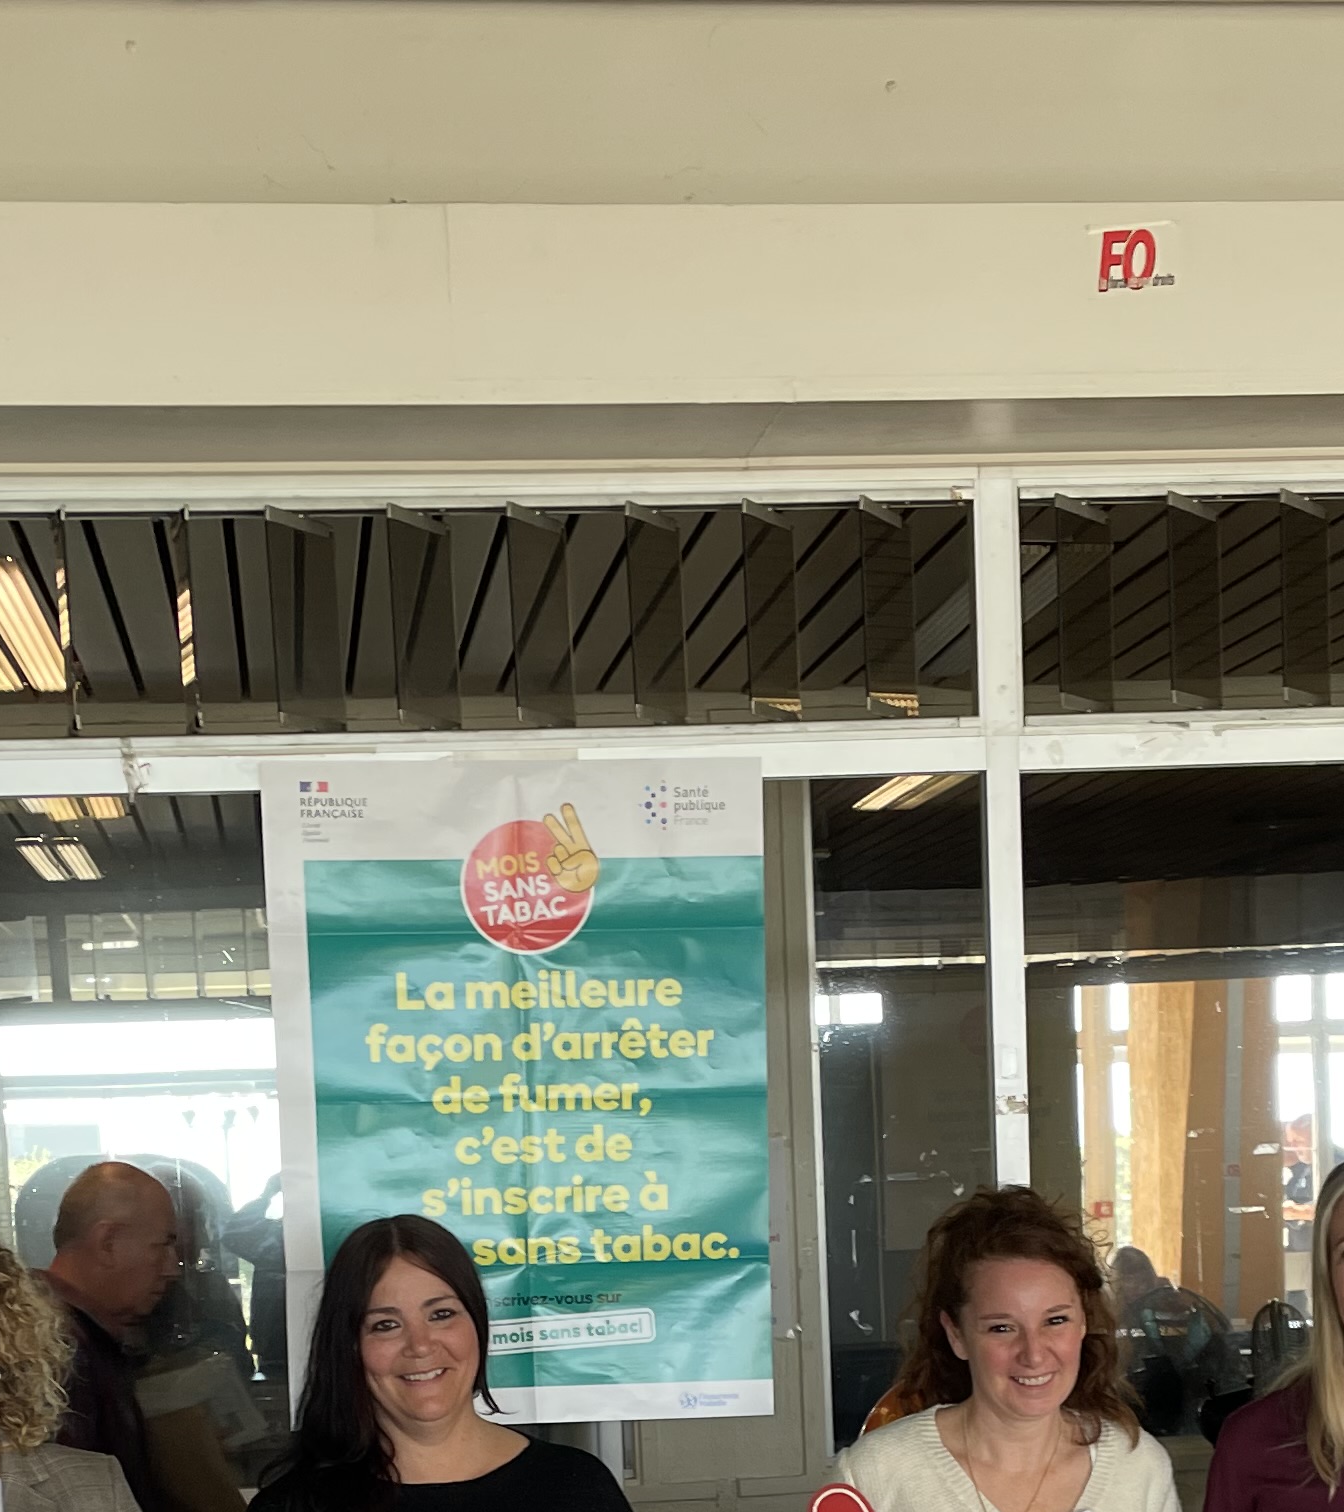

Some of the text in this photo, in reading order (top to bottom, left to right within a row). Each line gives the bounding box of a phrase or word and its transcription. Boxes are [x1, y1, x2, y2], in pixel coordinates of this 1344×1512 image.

[1098, 229, 1156, 292] FO
[299, 797, 368, 808] RÉPUBLIQUE
[673, 785, 709, 797] Santé
[299, 809, 364, 819] FRANÇAISE
[674, 800, 726, 813] publique
[476, 851, 540, 879] MOIS
[483, 874, 551, 902] SANS
[480, 896, 568, 926] TABAC
[396, 970, 683, 1010] La meilleure
[365, 1018, 714, 1071] façon d’arrêter
[432, 1073, 652, 1116] de fumer,
[455, 1124, 633, 1165] c’est de
[422, 1171, 669, 1217] s’inscrire à
[473, 1225, 740, 1266] sans tabac.
[596, 1291, 623, 1304] sur
[492, 1327, 534, 1345] mois
[539, 1324, 581, 1340] sans
